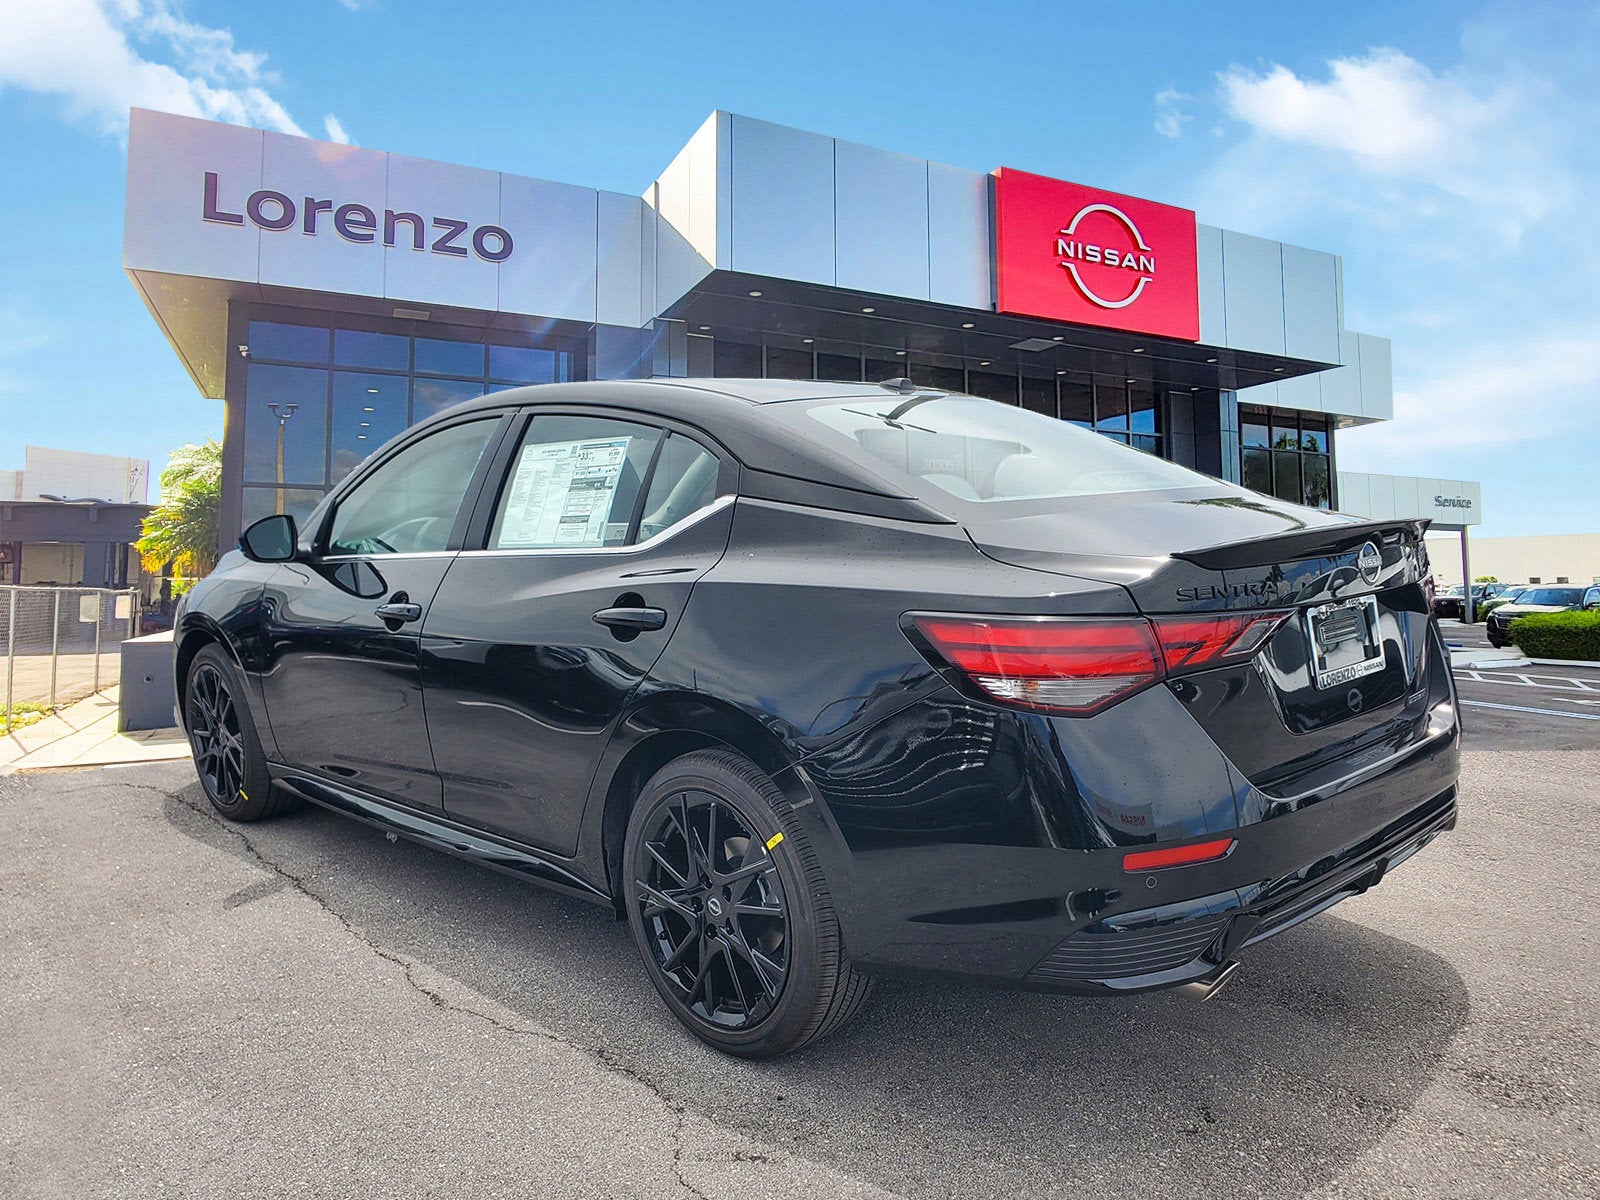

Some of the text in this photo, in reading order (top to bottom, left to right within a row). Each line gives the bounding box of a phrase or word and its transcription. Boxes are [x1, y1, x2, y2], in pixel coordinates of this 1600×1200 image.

[202, 171, 514, 262] Lorenzo
[1057, 238, 1155, 273] NISSAN
[1434, 495, 1472, 508] Service
[1176, 582, 1278, 602] SENTRA
[1320, 667, 1356, 687] LORENZO
